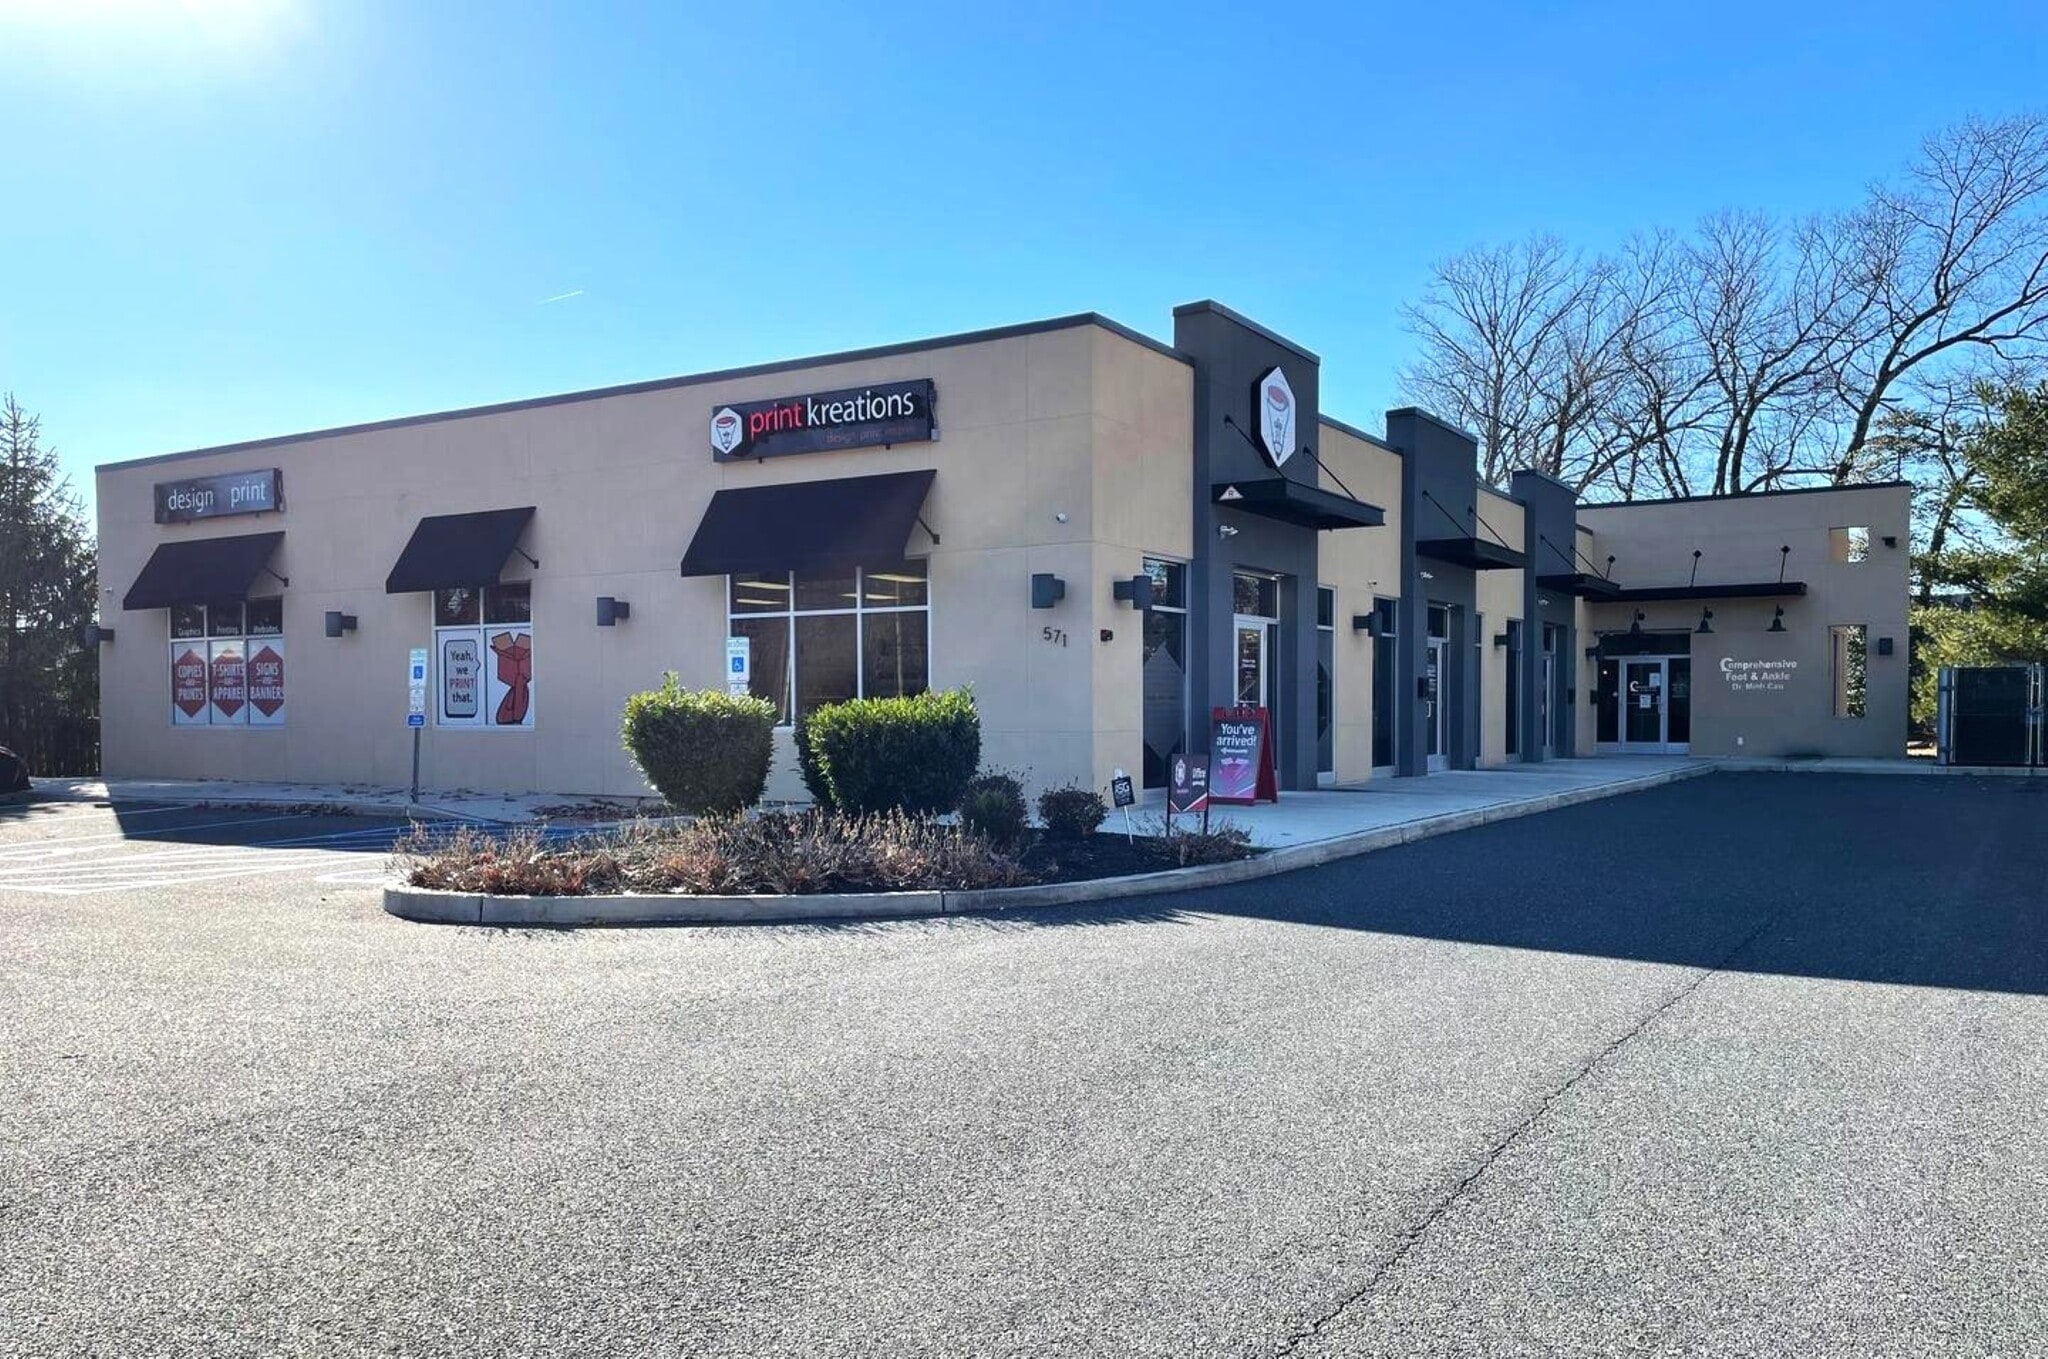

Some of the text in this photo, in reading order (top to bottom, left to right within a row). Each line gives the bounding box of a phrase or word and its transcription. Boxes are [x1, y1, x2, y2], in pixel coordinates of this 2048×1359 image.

[750, 390, 914, 440] print kreations
[168, 481, 266, 513] design print
[1043, 626, 1067, 648] 571
[450, 650, 474, 661] Yeah,
[256, 662, 279, 677] SIGNS
[456, 666, 469, 675] we
[1720, 657, 1798, 672] Comprehensive
[178, 665, 203, 678] COPIES
[1726, 671, 1792, 681] Foot & Ankle
[450, 678, 475, 688] PRINT
[178, 688, 203, 700] PRINTS
[452, 692, 473, 704] that.
[1220, 723, 1255, 735] You've
[1216, 735, 1257, 747] arrived!
